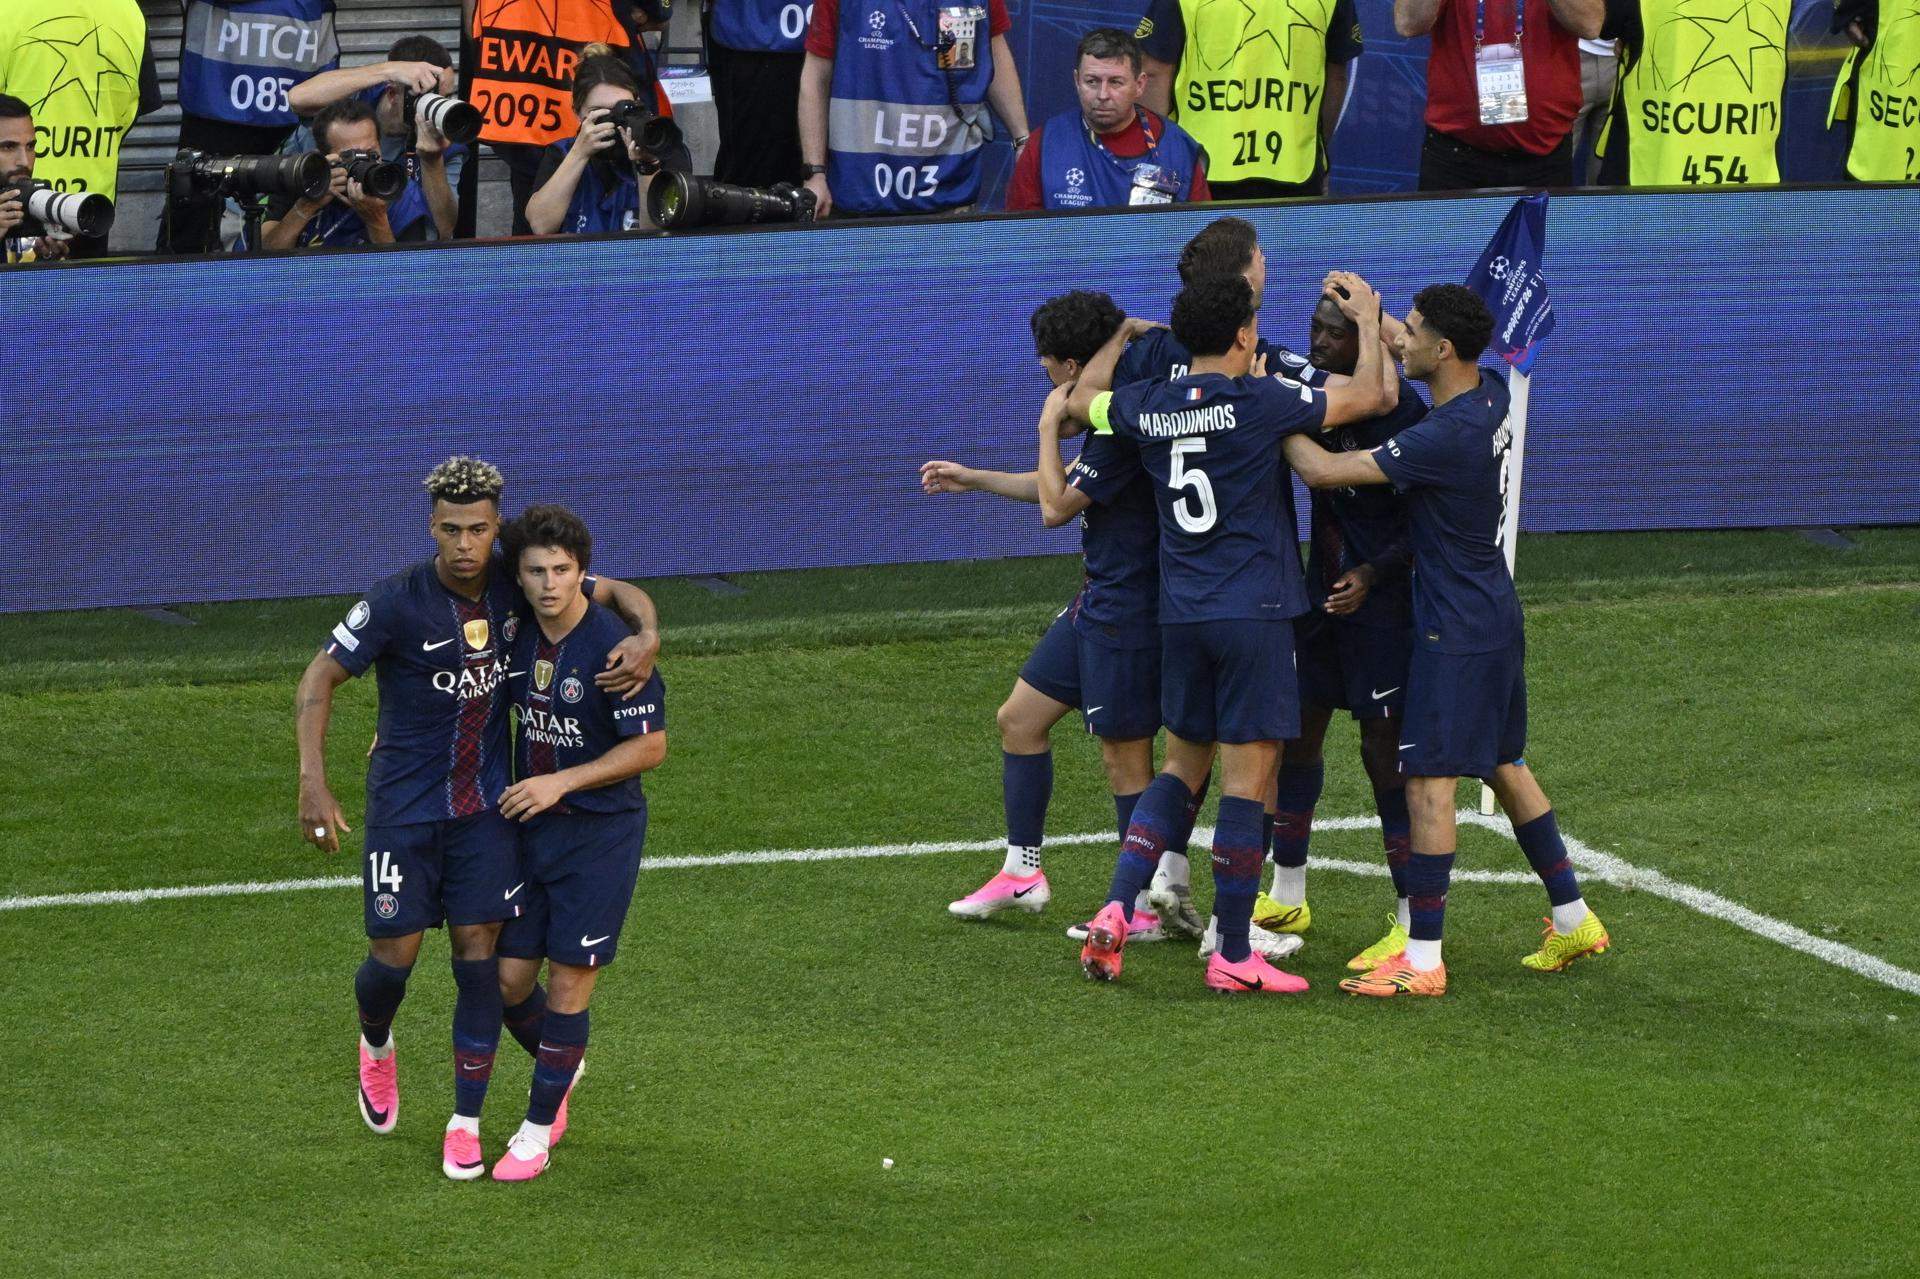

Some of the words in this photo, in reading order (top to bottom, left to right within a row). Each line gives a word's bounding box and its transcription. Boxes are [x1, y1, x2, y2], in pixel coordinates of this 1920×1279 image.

[218, 19, 319, 63] PITCH
[858, 36, 894, 45] CHAMPIONS
[231, 74, 295, 112] 085
[477, 89, 562, 132] 2095
[1187, 77, 1320, 114] SECURITY
[1870, 89, 1920, 128] SEC
[875, 110, 947, 148] LED
[1642, 99, 1777, 135] SECURITY
[35, 125, 123, 158] CURIT
[1232, 129, 1282, 166] 219
[875, 163, 939, 199] 003
[1682, 155, 1749, 185] 454
[1054, 193, 1093, 201] CHAMPIONS
[1502, 259, 1527, 306] CHAMPIONS
[1509, 271, 1527, 302] LEAGUE
[1139, 404, 1236, 437] MARQUINHOS
[1168, 436, 1217, 533] 5
[613, 703, 656, 720] EYOND
[525, 726, 584, 748] AIRWAYS
[369, 851, 404, 892] 14
